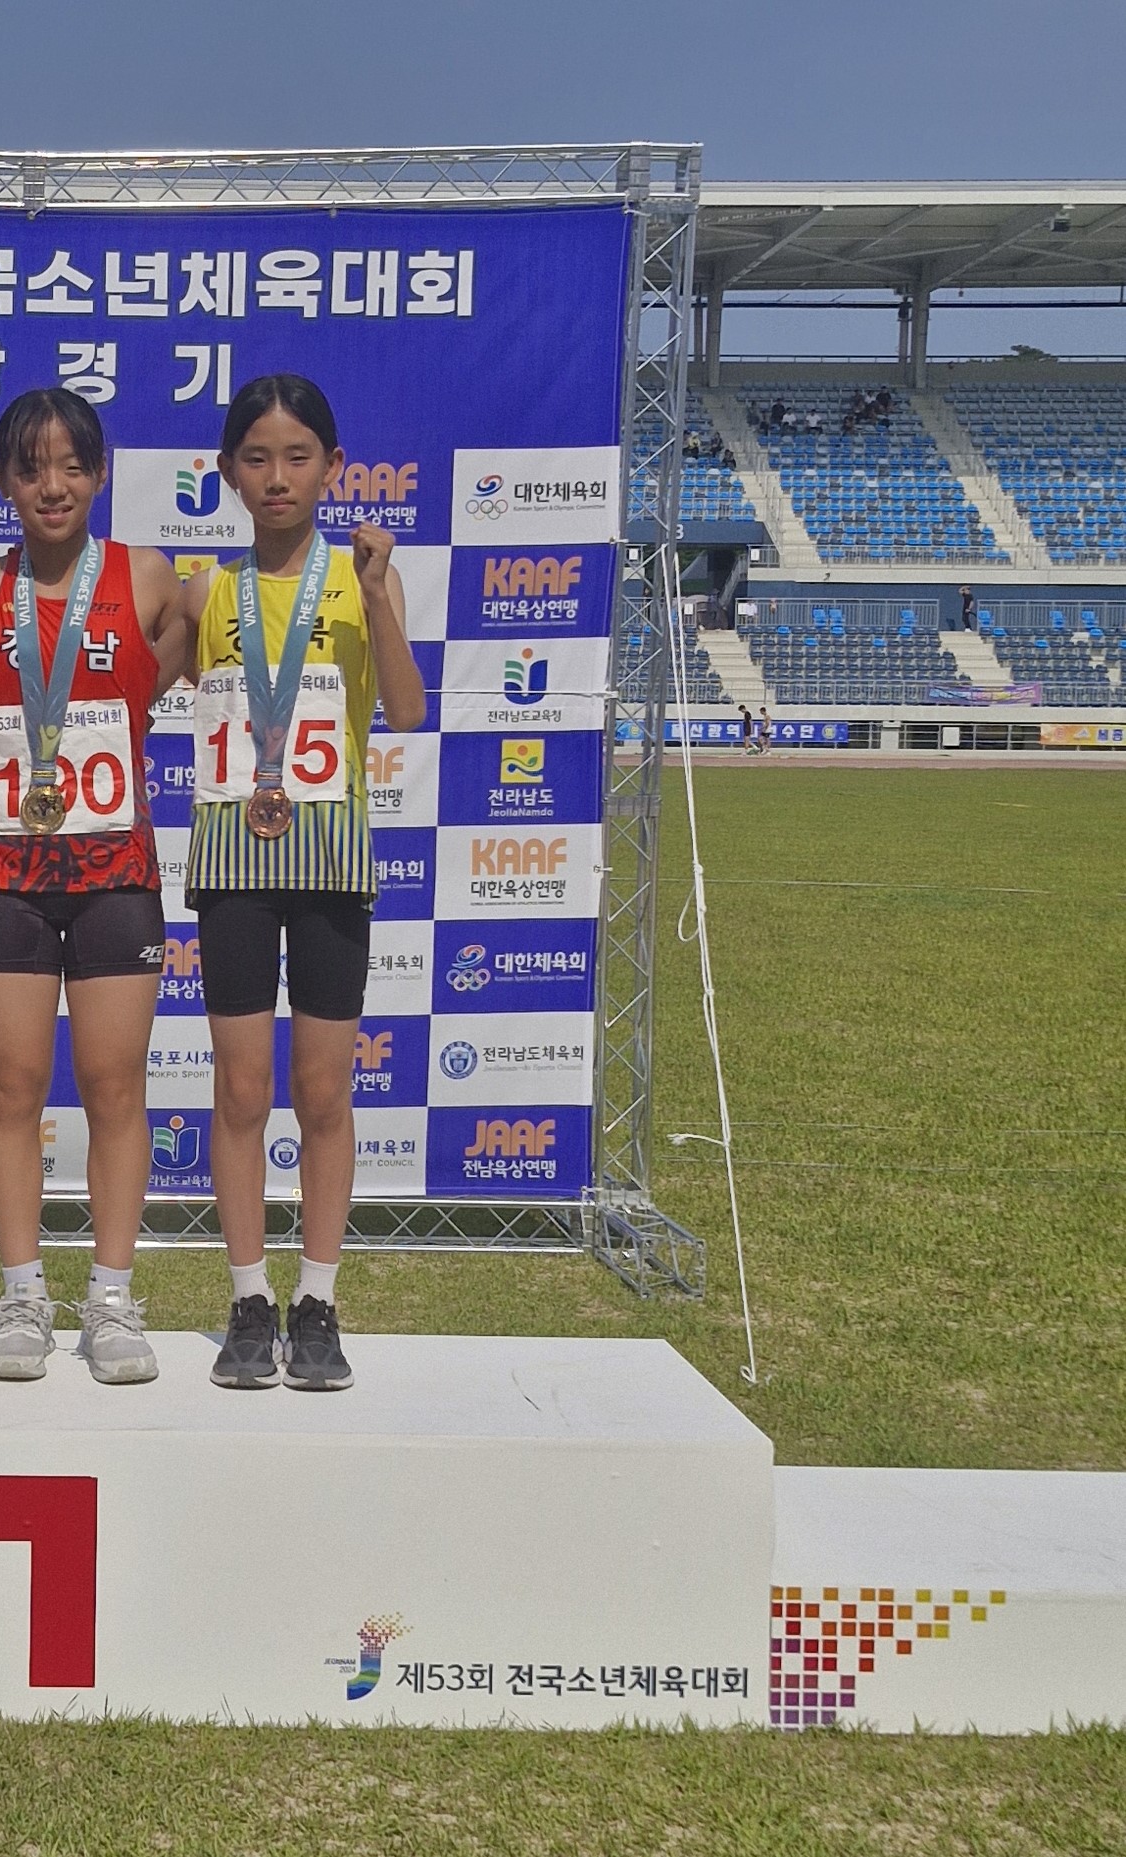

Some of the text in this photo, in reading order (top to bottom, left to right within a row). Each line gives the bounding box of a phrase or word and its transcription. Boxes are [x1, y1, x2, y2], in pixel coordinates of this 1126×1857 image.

[514, 481, 607, 503] 대한체육회
[318, 505, 418, 526] 대한육상연맹
[159, 524, 236, 538] 전라남도교육청
[483, 556, 583, 598] KAAF
[481, 600, 579, 620] 대한육상연맹
[200, 677, 234, 695] 제53회
[487, 708, 563, 724] 전라남도교육청
[208, 719, 339, 785] 15
[367, 788, 403, 808] 연맹
[487, 788, 555, 807] 전라남도
[487, 808, 554, 818] JeollaNamdo
[471, 837, 568, 877] KAAF
[470, 879, 566, 899] 대한육상연맹
[495, 951, 587, 974] 대한체육회
[482, 1045, 585, 1063] 전라남도체육회
[464, 1119, 556, 1156] JAAF
[462, 1160, 557, 1180] 전남육상연맹
[395, 1661, 749, 1699] 제53회 전국소년체육대회
